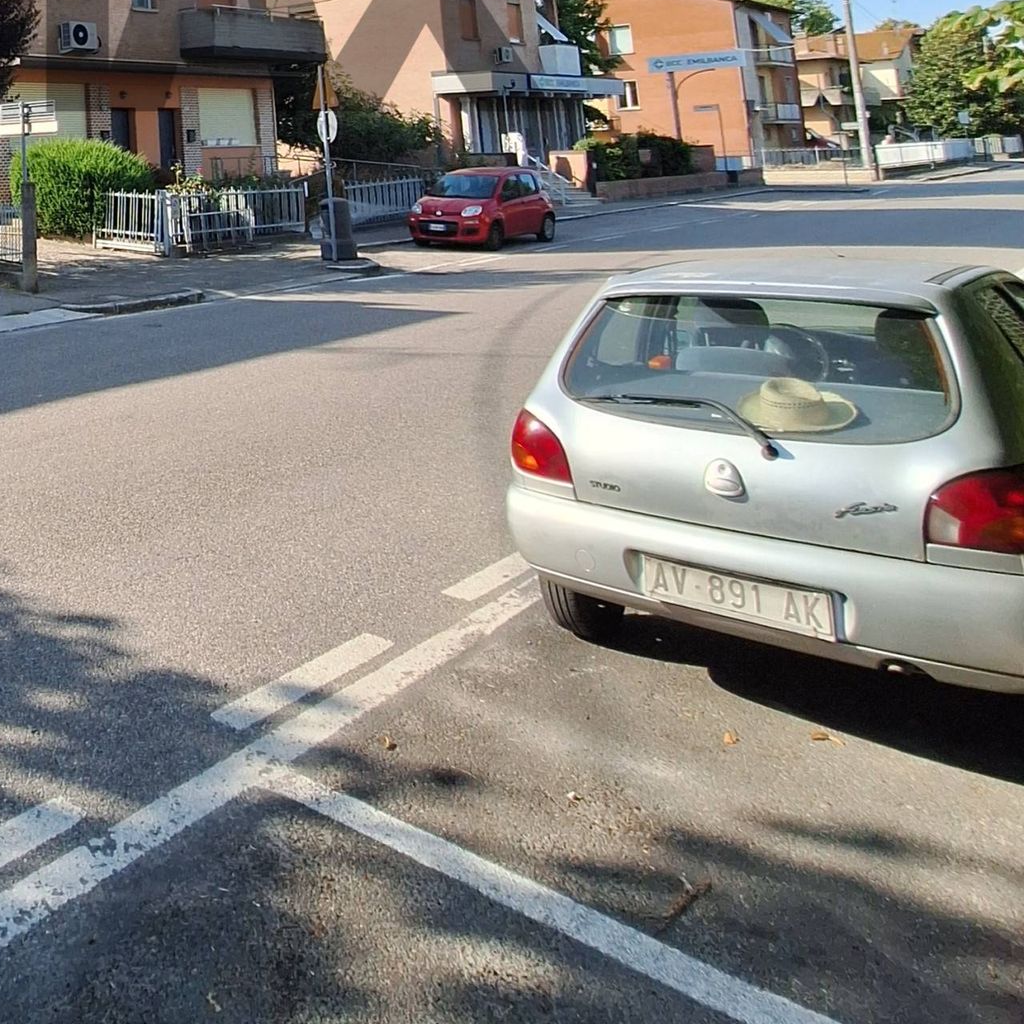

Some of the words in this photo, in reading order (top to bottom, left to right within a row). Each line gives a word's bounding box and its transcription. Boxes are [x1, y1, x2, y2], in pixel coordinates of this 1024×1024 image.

[588, 480, 622, 493] STUDIO
[707, 574, 761, 614] 891
[783, 591, 823, 630] AK
